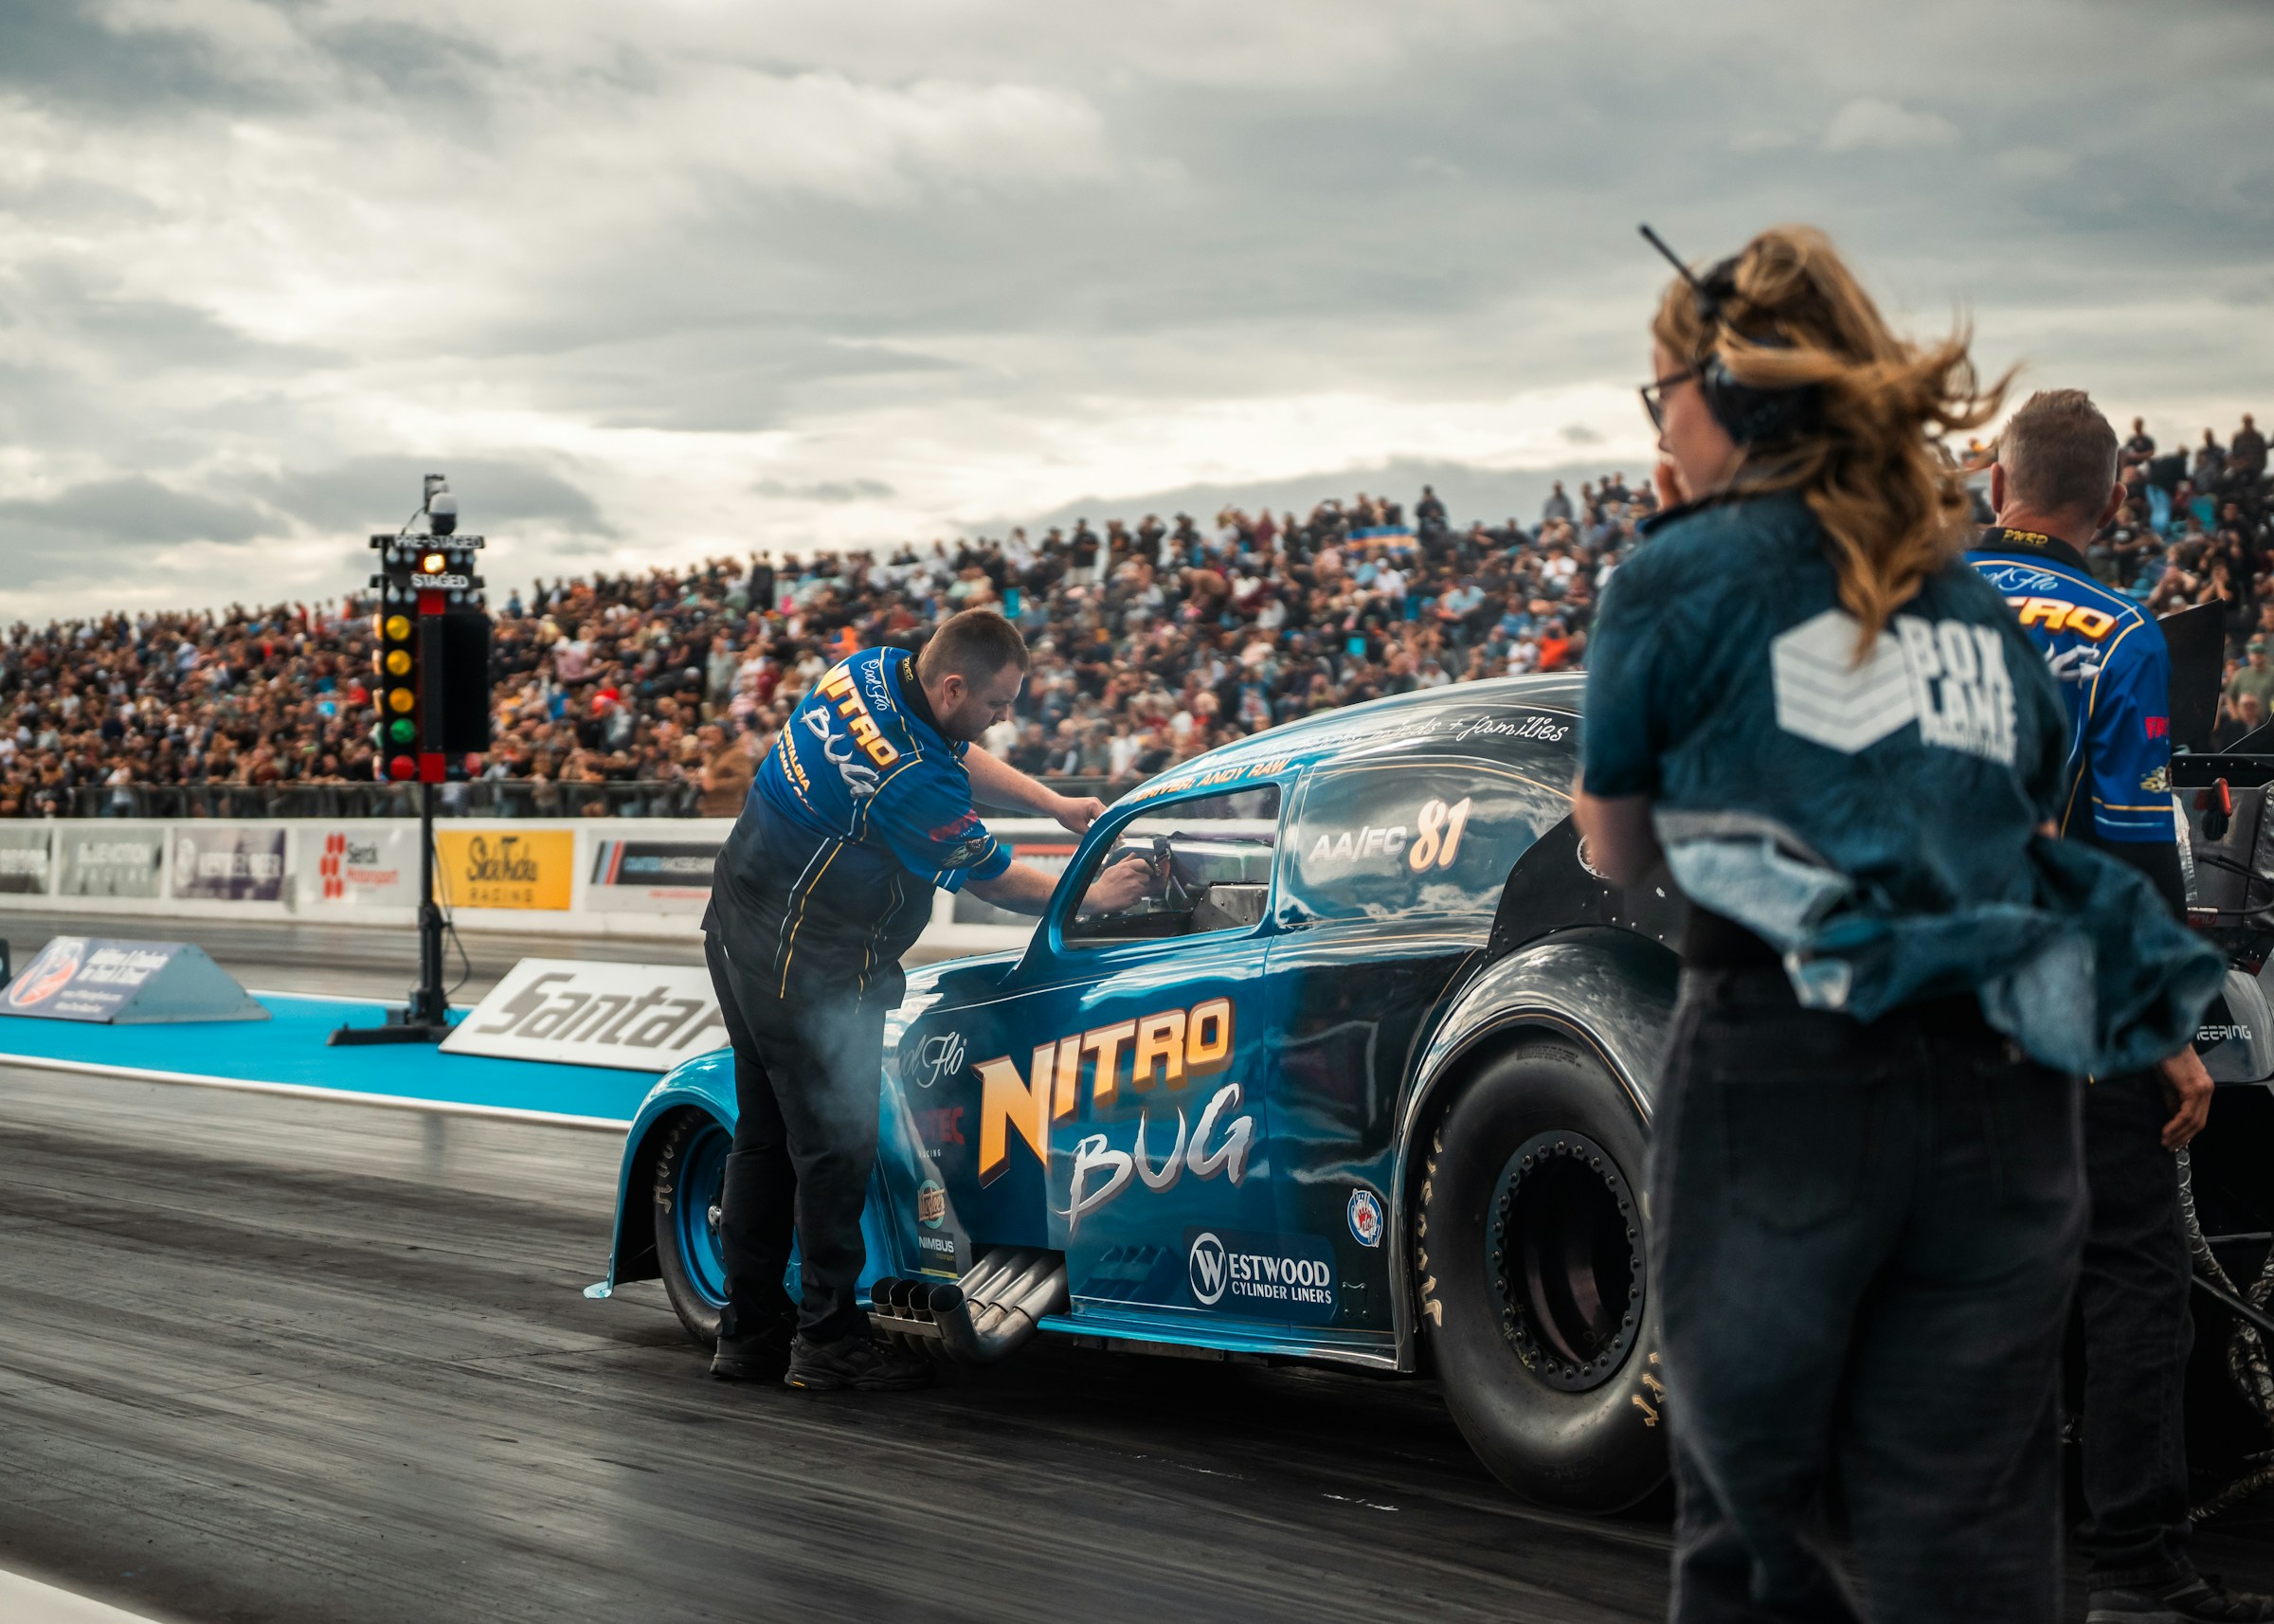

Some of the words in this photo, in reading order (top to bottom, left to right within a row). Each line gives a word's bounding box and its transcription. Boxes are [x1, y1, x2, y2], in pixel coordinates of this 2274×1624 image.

[394, 535, 482, 550] PRE-STAGED
[410, 572, 469, 587] STAGED
[1456, 715, 1569, 742] families
[798, 704, 880, 797] BUG
[1197, 765, 1252, 787] ANDY
[1247, 758, 1292, 778] RAW
[1308, 825, 1407, 864] AA/FC
[1408, 796, 1472, 873] 81
[970, 996, 1236, 1190] NITRO
[1054, 1082, 1253, 1233] BUG
[918, 1236, 955, 1254] NIMBUS
[1232, 1280, 1288, 1300] CYLINDER
[1290, 1289, 1332, 1305] LINERS
